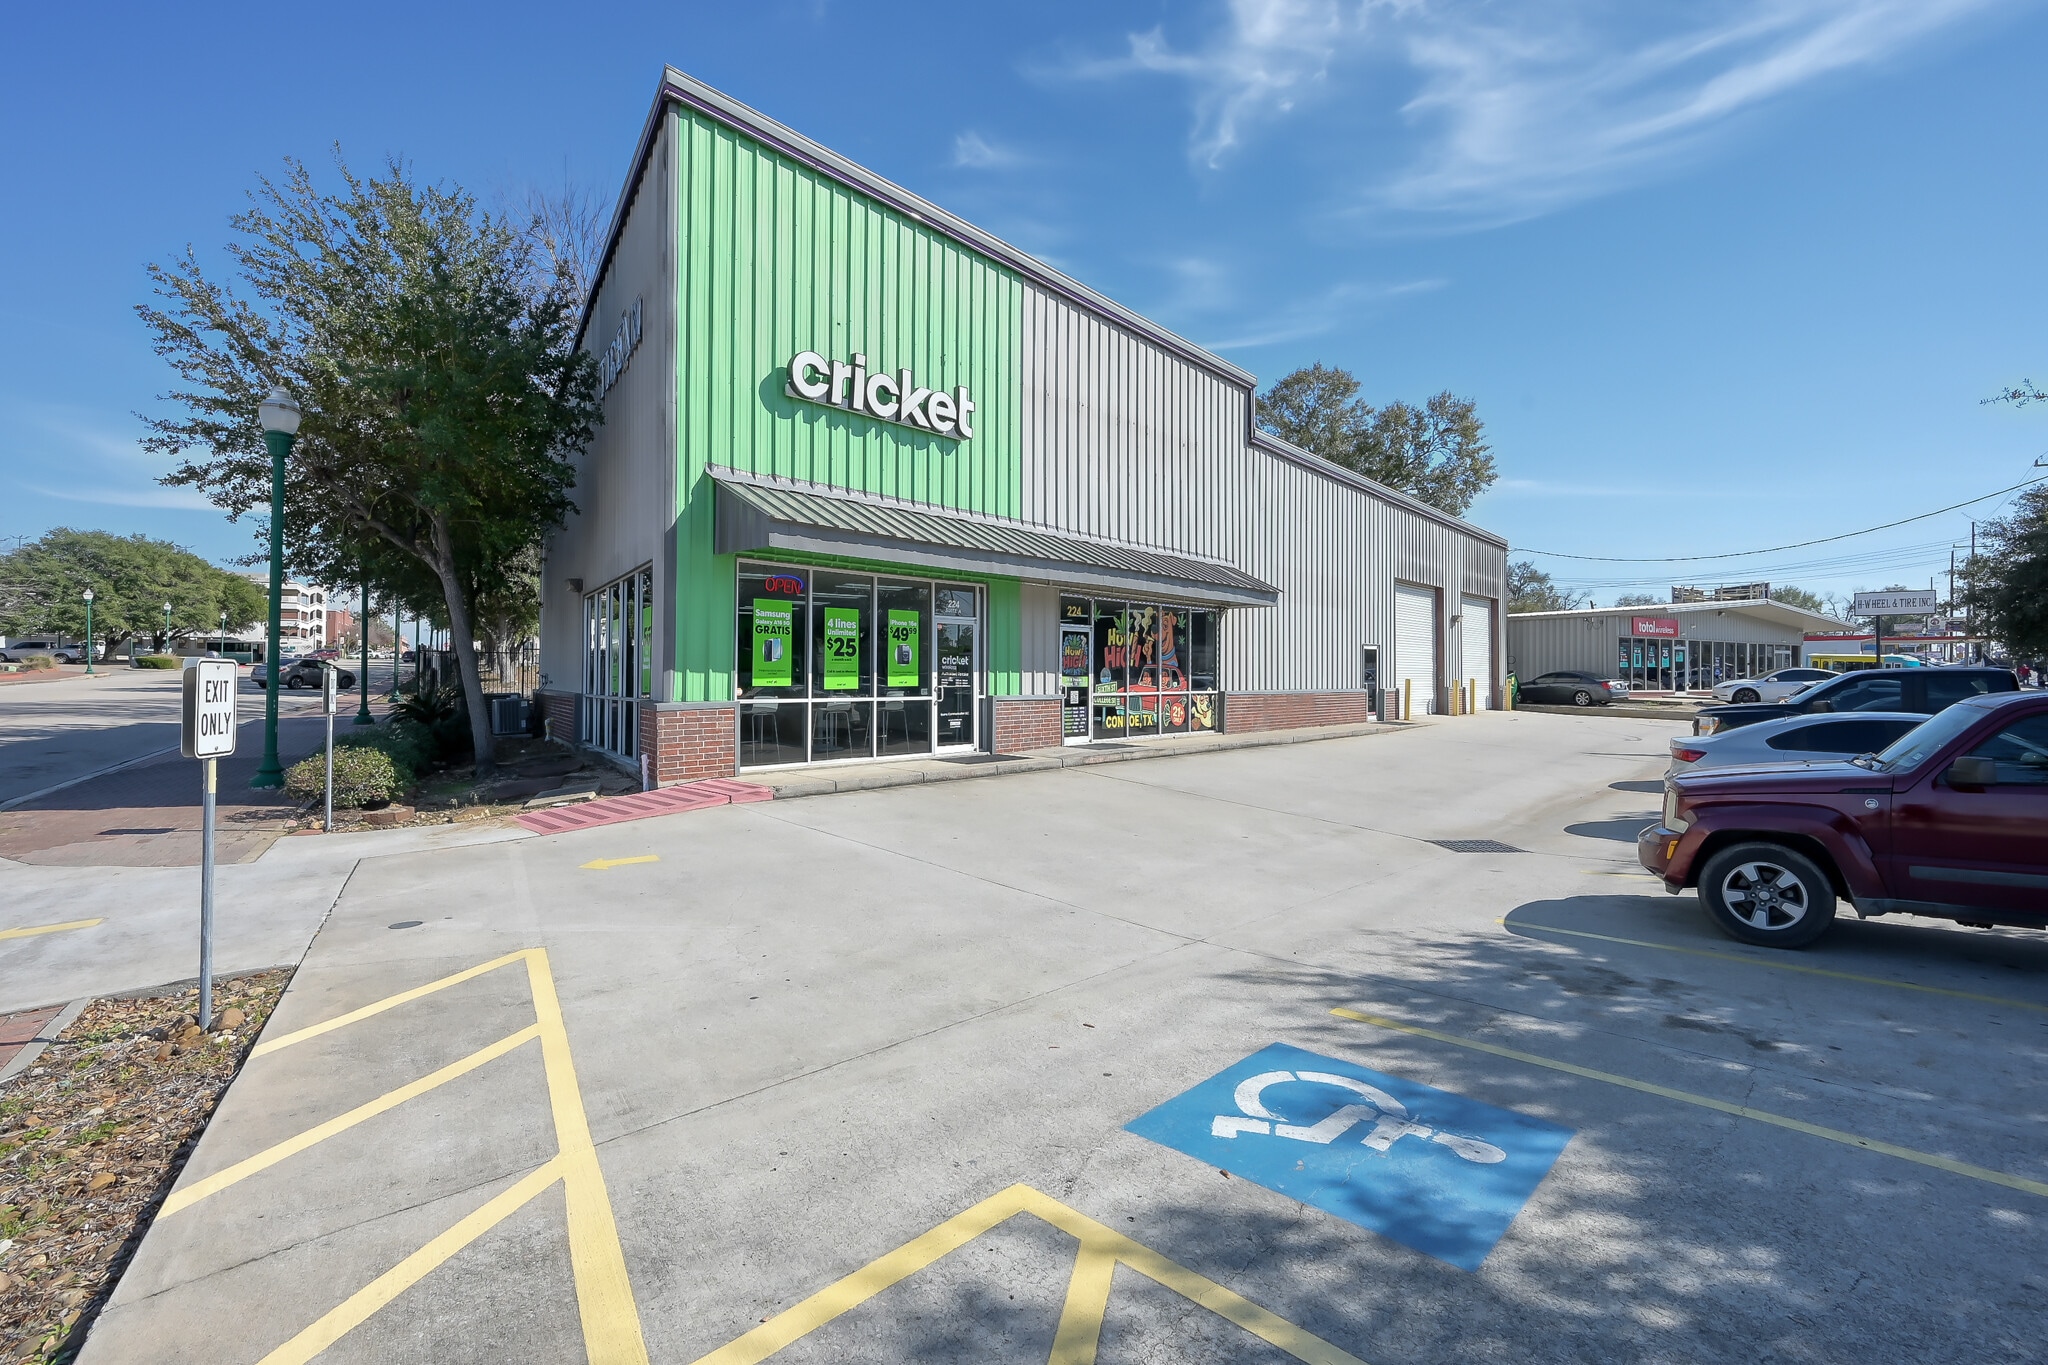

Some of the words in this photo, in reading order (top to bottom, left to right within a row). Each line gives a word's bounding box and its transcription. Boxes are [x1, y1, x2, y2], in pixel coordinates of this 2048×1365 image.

[788, 350, 975, 439] cricket
[765, 577, 801, 594] OPEN
[947, 599, 960, 608] 224
[1900, 597, 1917, 608] TIRE
[1918, 597, 1933, 607] INC.
[755, 609, 791, 620] Samsung
[1066, 605, 1081, 616] 224
[827, 618, 834, 628] 4
[835, 618, 857, 629] lines
[1638, 620, 1656, 633] total
[1656, 625, 1674, 634] wireless
[755, 625, 790, 635] GRATIS
[827, 628, 857, 636] Unlimited
[826, 637, 857, 657] $25
[941, 655, 969, 666] cricket
[205, 680, 229, 703] EXIT
[1172, 706, 1184, 717] 21+
[201, 712, 232, 736] ONLY
[1106, 715, 1142, 729] CONOE,
[1142, 714, 1153, 726] TX
